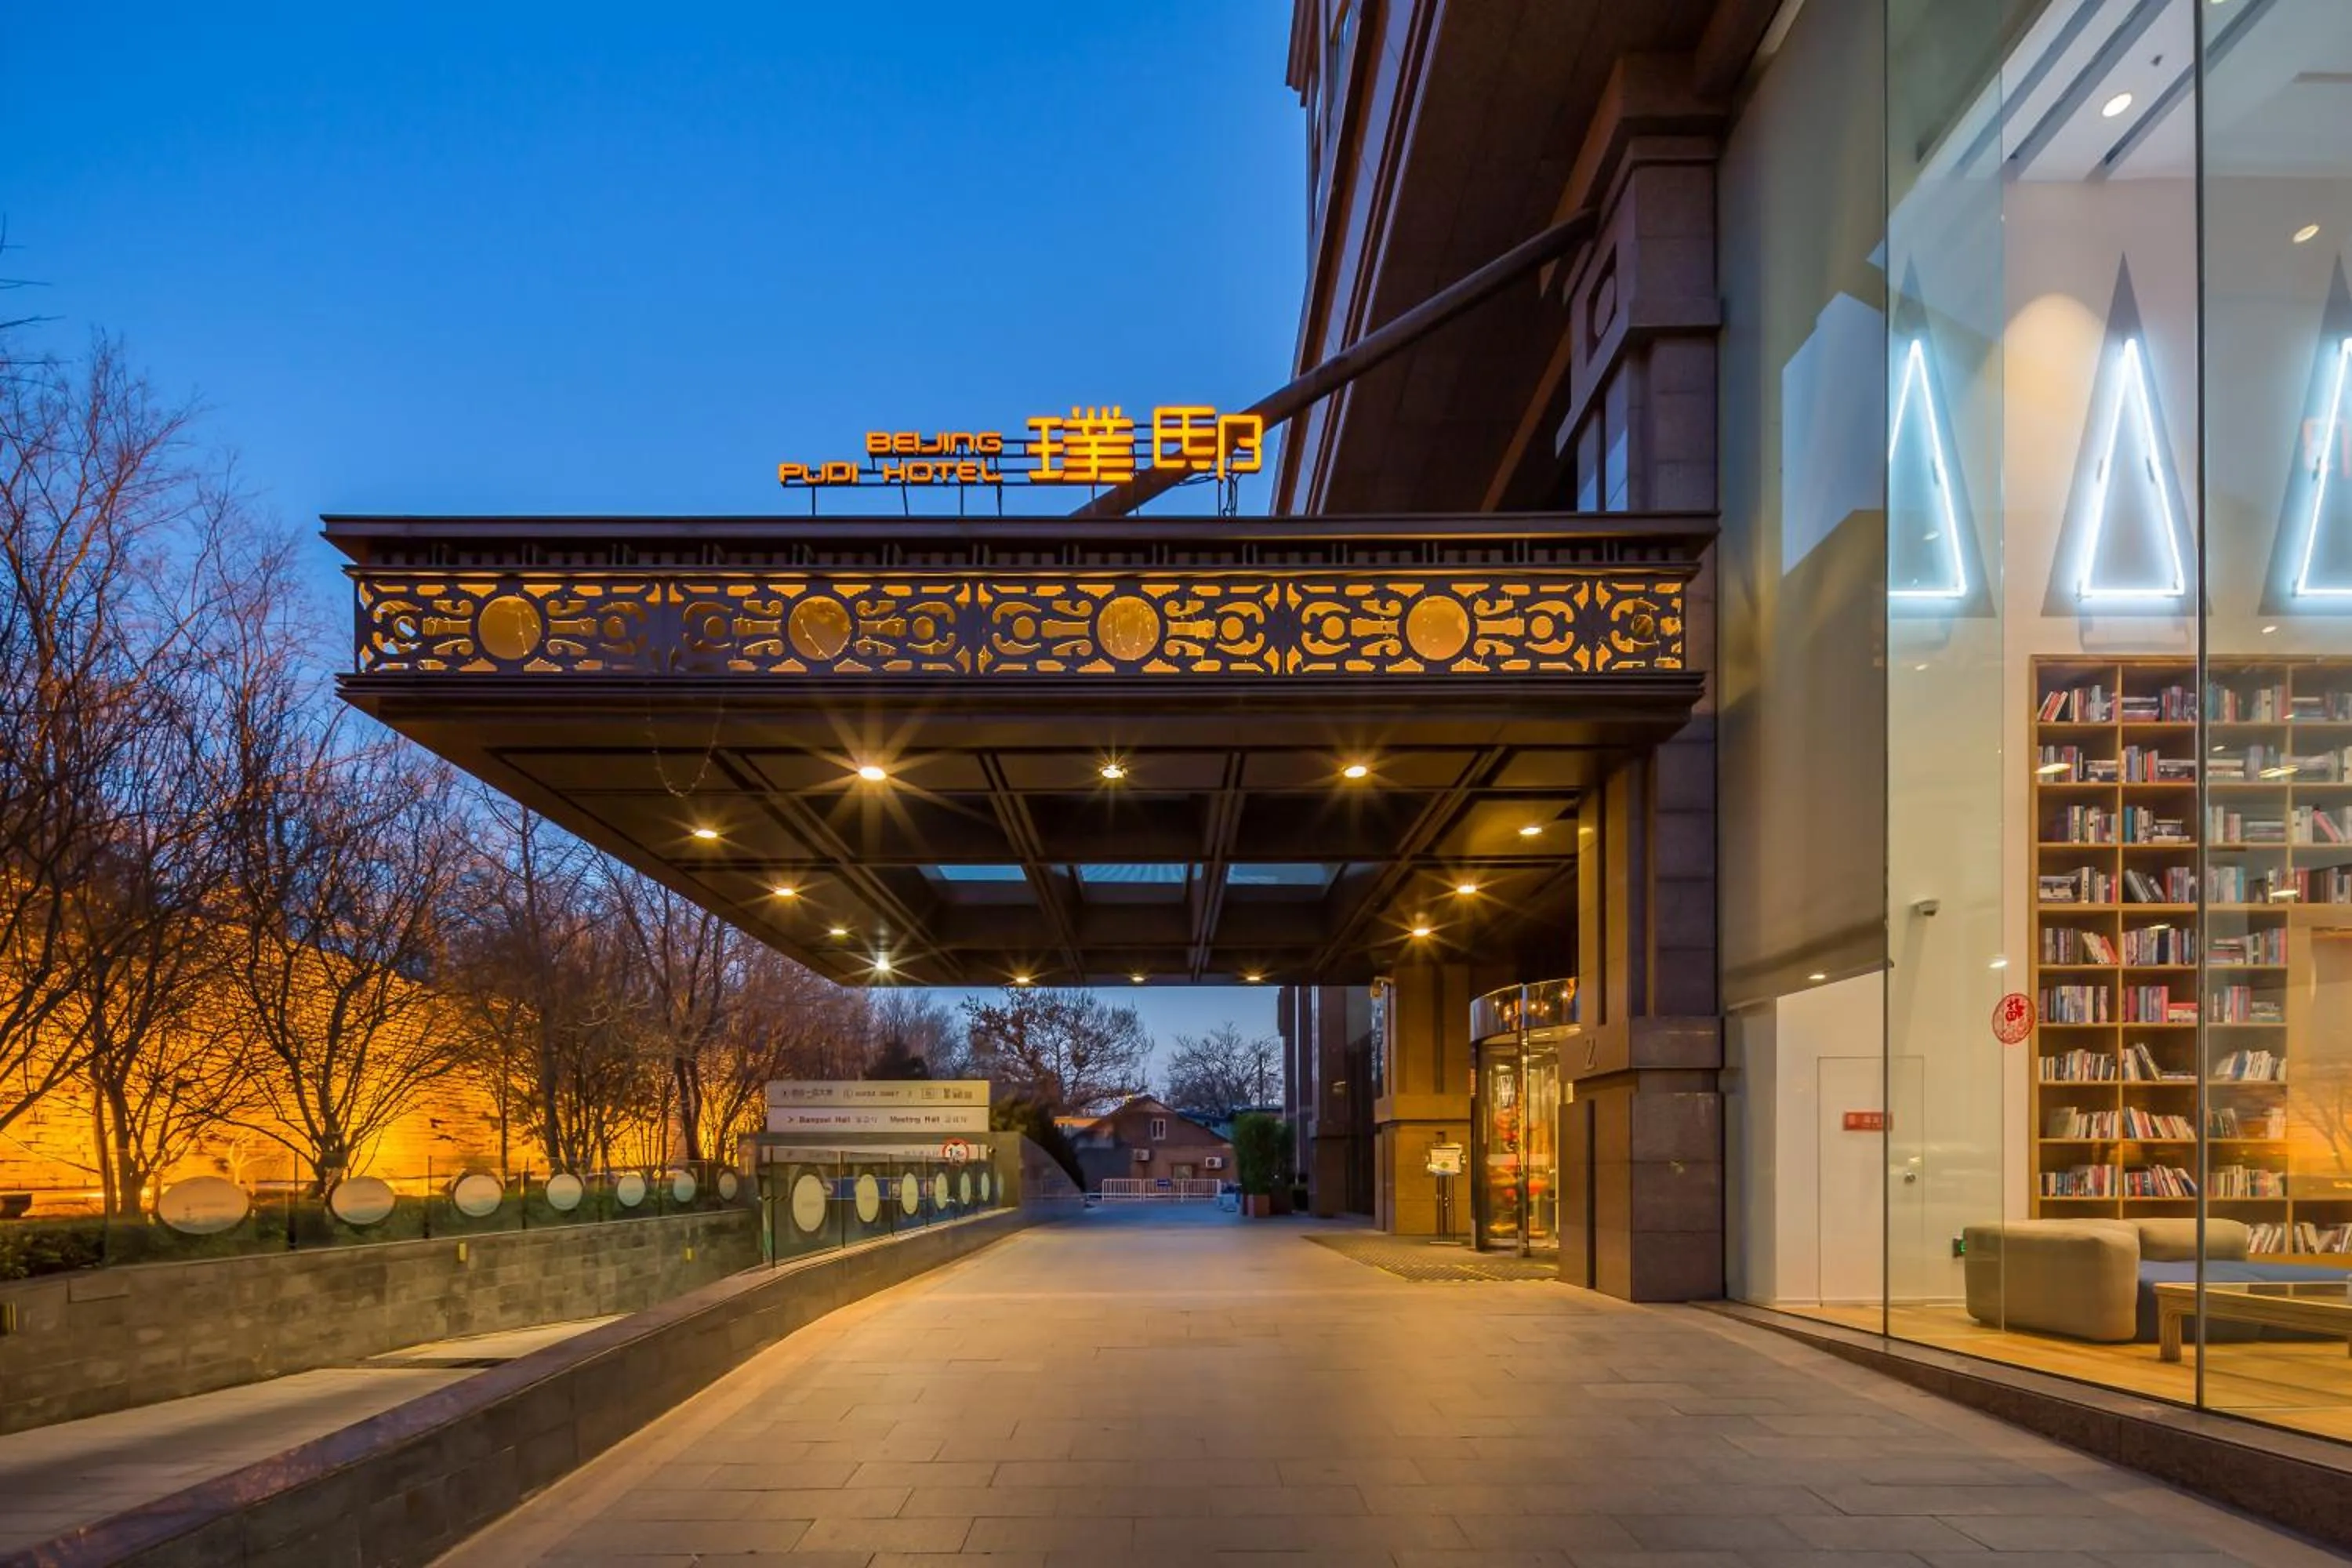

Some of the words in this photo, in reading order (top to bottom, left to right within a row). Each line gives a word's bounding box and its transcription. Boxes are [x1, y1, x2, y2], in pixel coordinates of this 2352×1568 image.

[866, 431, 1003, 454] BEIJING
[779, 463, 859, 483] PUDI
[882, 460, 1004, 483] HOTEL
